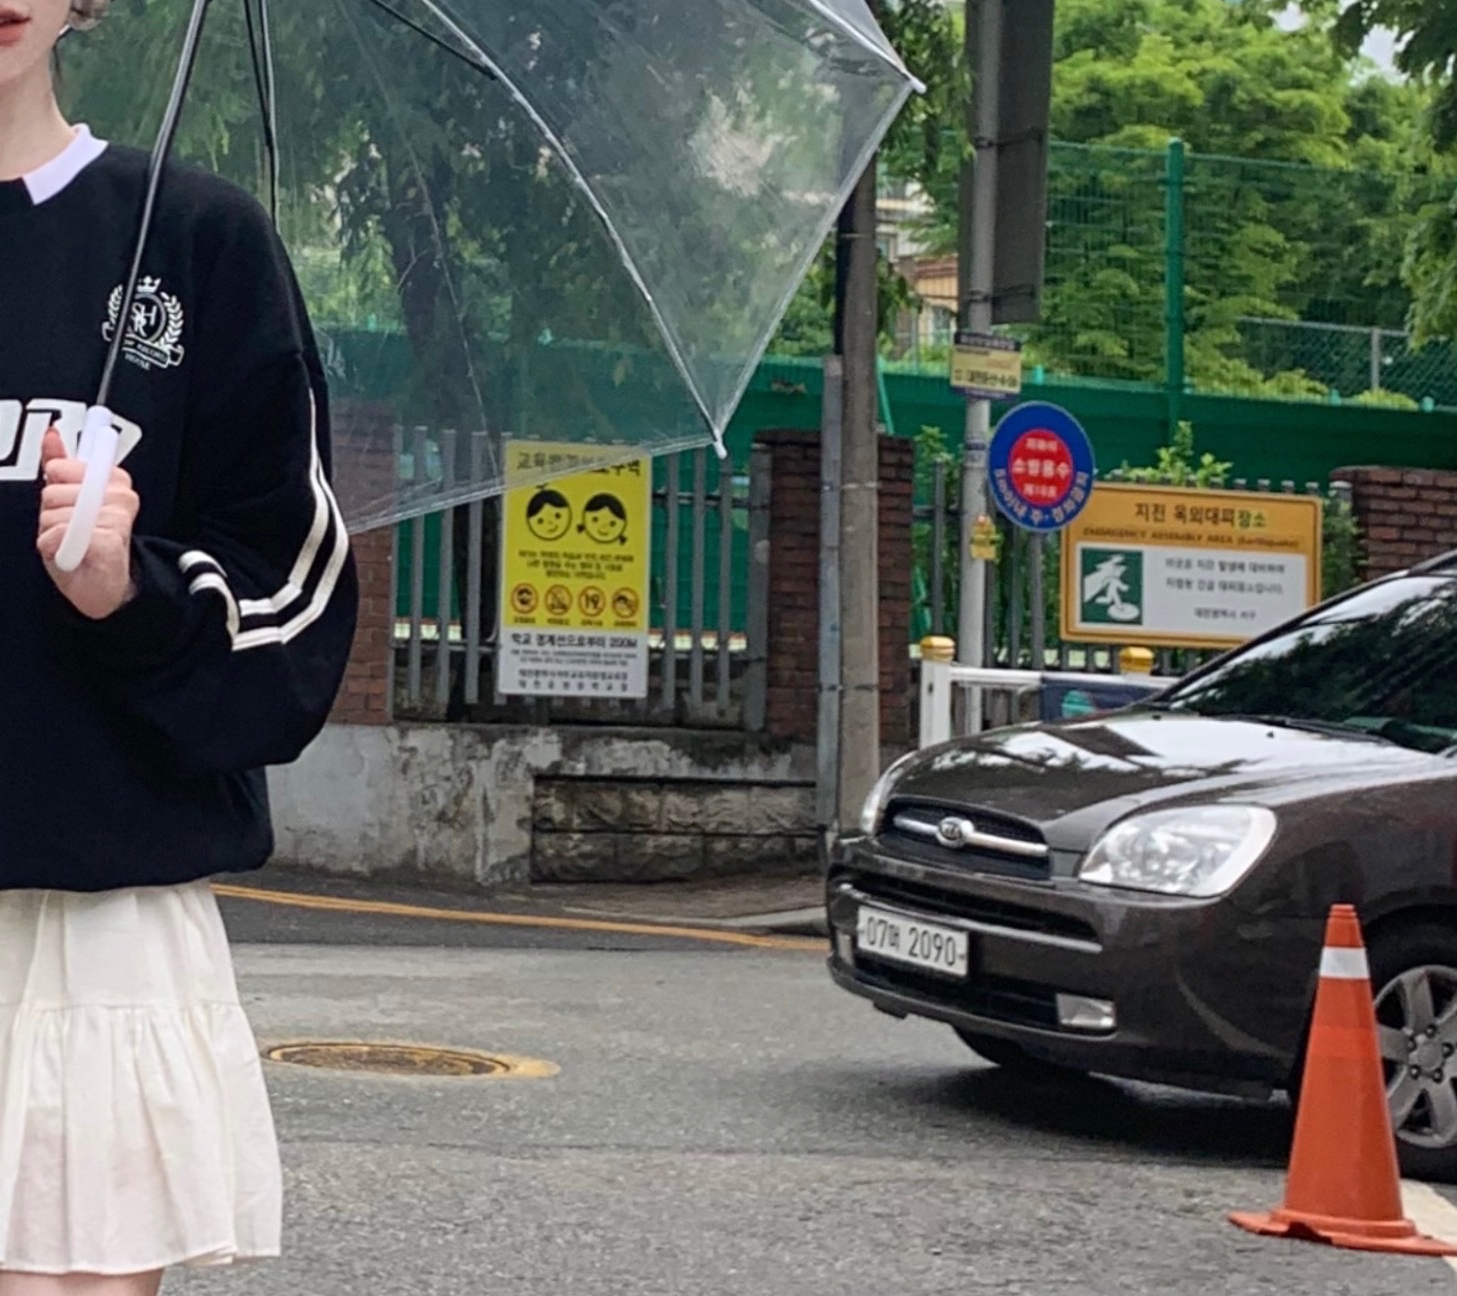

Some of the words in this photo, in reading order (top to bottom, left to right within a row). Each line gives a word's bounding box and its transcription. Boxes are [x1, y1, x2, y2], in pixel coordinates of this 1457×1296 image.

[1012, 457, 1070, 480] 소방용수
[1174, 505, 1268, 529] 옥외대피장소
[1150, 531, 1203, 543] ASSEMBLY
[1207, 534, 1234, 546] AREA
[1194, 607, 1237, 619] 대전광역시
[511, 633, 532, 645] 학교
[536, 634, 606, 648] 경계선으로부터
[908, 926, 956, 967] 2090
